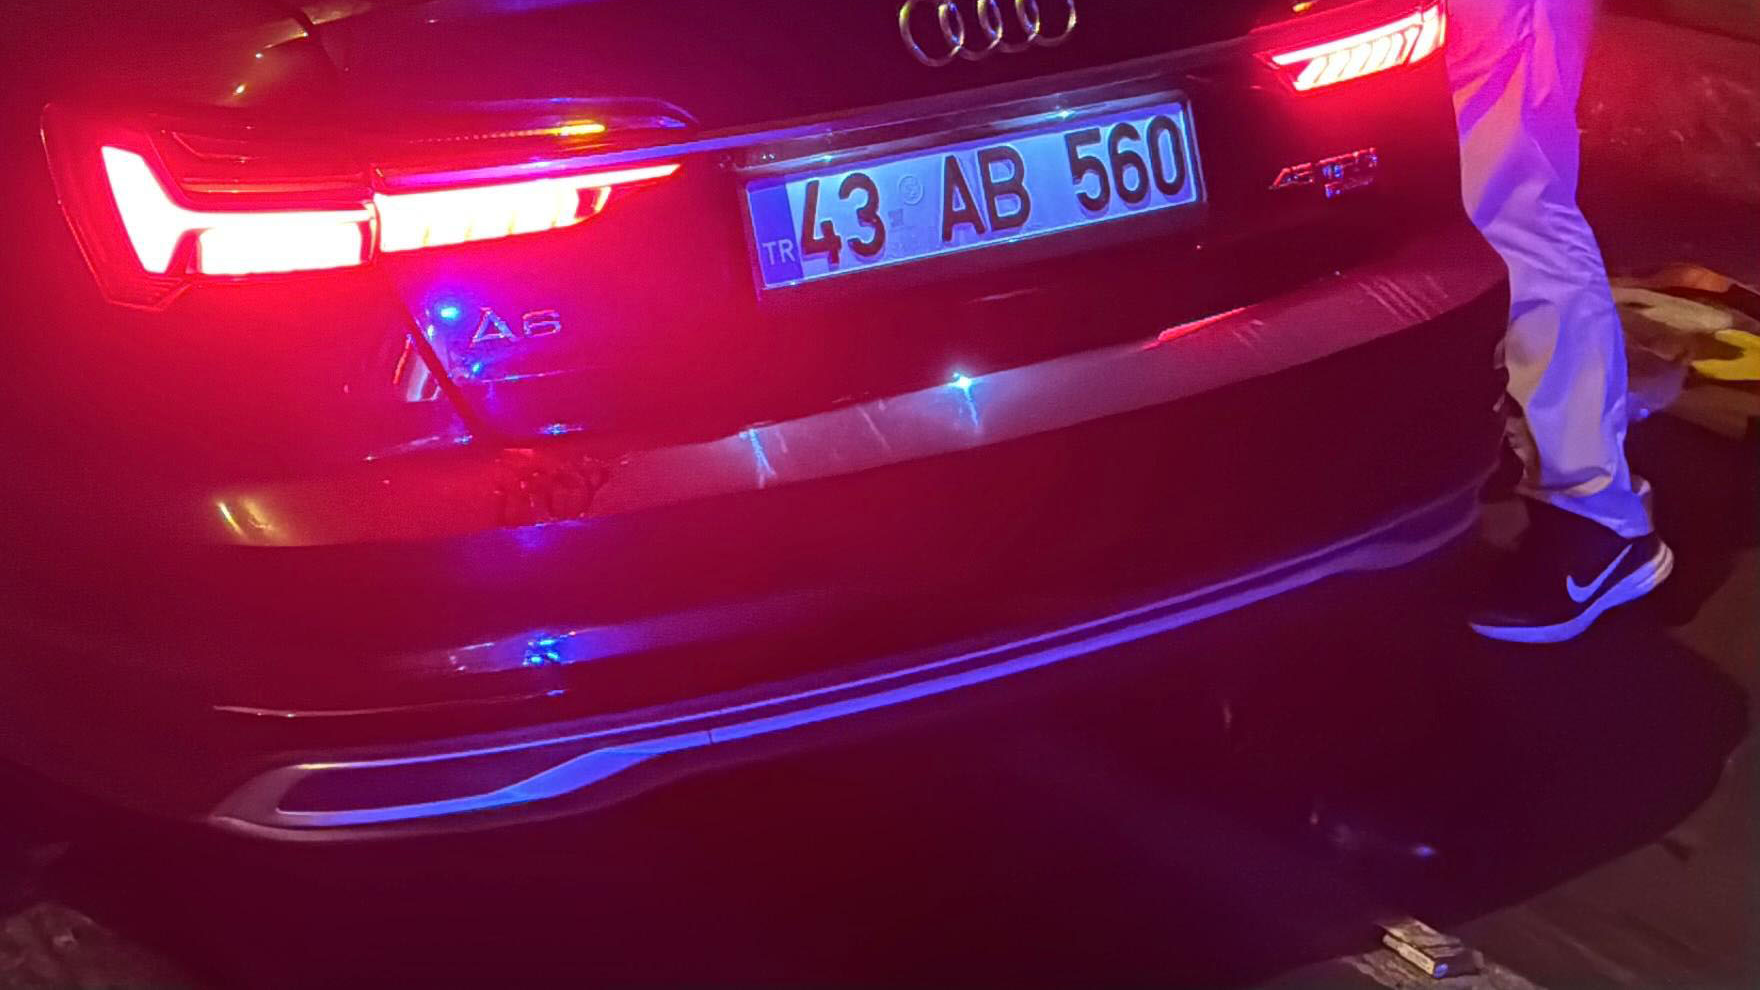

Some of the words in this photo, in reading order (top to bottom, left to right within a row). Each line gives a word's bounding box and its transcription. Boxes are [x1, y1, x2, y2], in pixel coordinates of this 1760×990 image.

[762, 240, 797, 268] TR
[800, 172, 887, 266] 43
[940, 144, 1032, 243] AB
[1064, 115, 1187, 213] 560
[469, 306, 563, 348] A6
